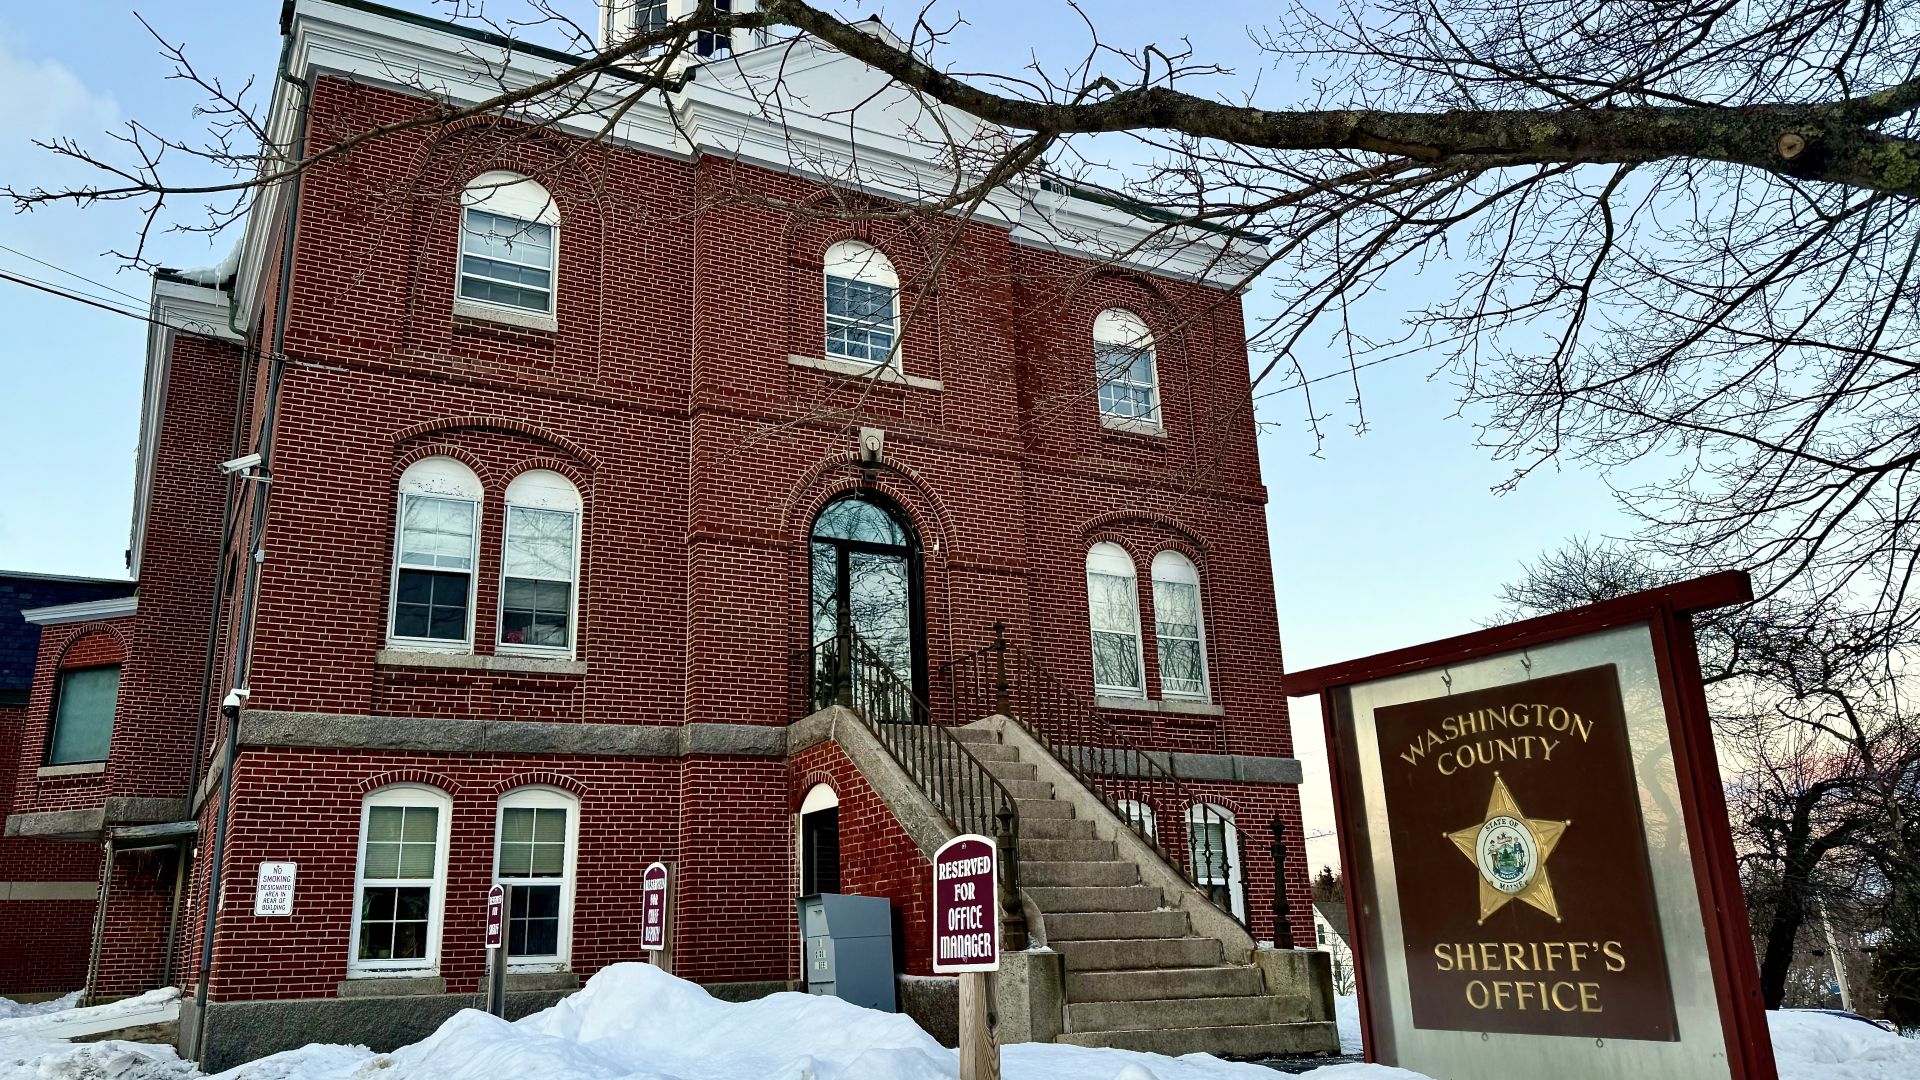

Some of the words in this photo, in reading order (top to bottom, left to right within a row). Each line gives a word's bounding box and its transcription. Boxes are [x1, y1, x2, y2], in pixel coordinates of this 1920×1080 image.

[1400, 703, 1594, 767] WASHINGTON
[1437, 736, 1561, 776] COUNTY
[1485, 818, 1507, 832] STATE
[1509, 820, 1519, 829] OF
[262, 875, 291, 883] SMOKING
[273, 867, 283, 875] NO
[938, 856, 991, 880] RESERVED
[954, 882, 975, 902] FOR
[948, 905, 983, 931] OFFICE
[940, 933, 992, 959] MANAGER
[1434, 940, 1627, 972] SHERIFF'S
[1465, 980, 1604, 1013] OFFICE
